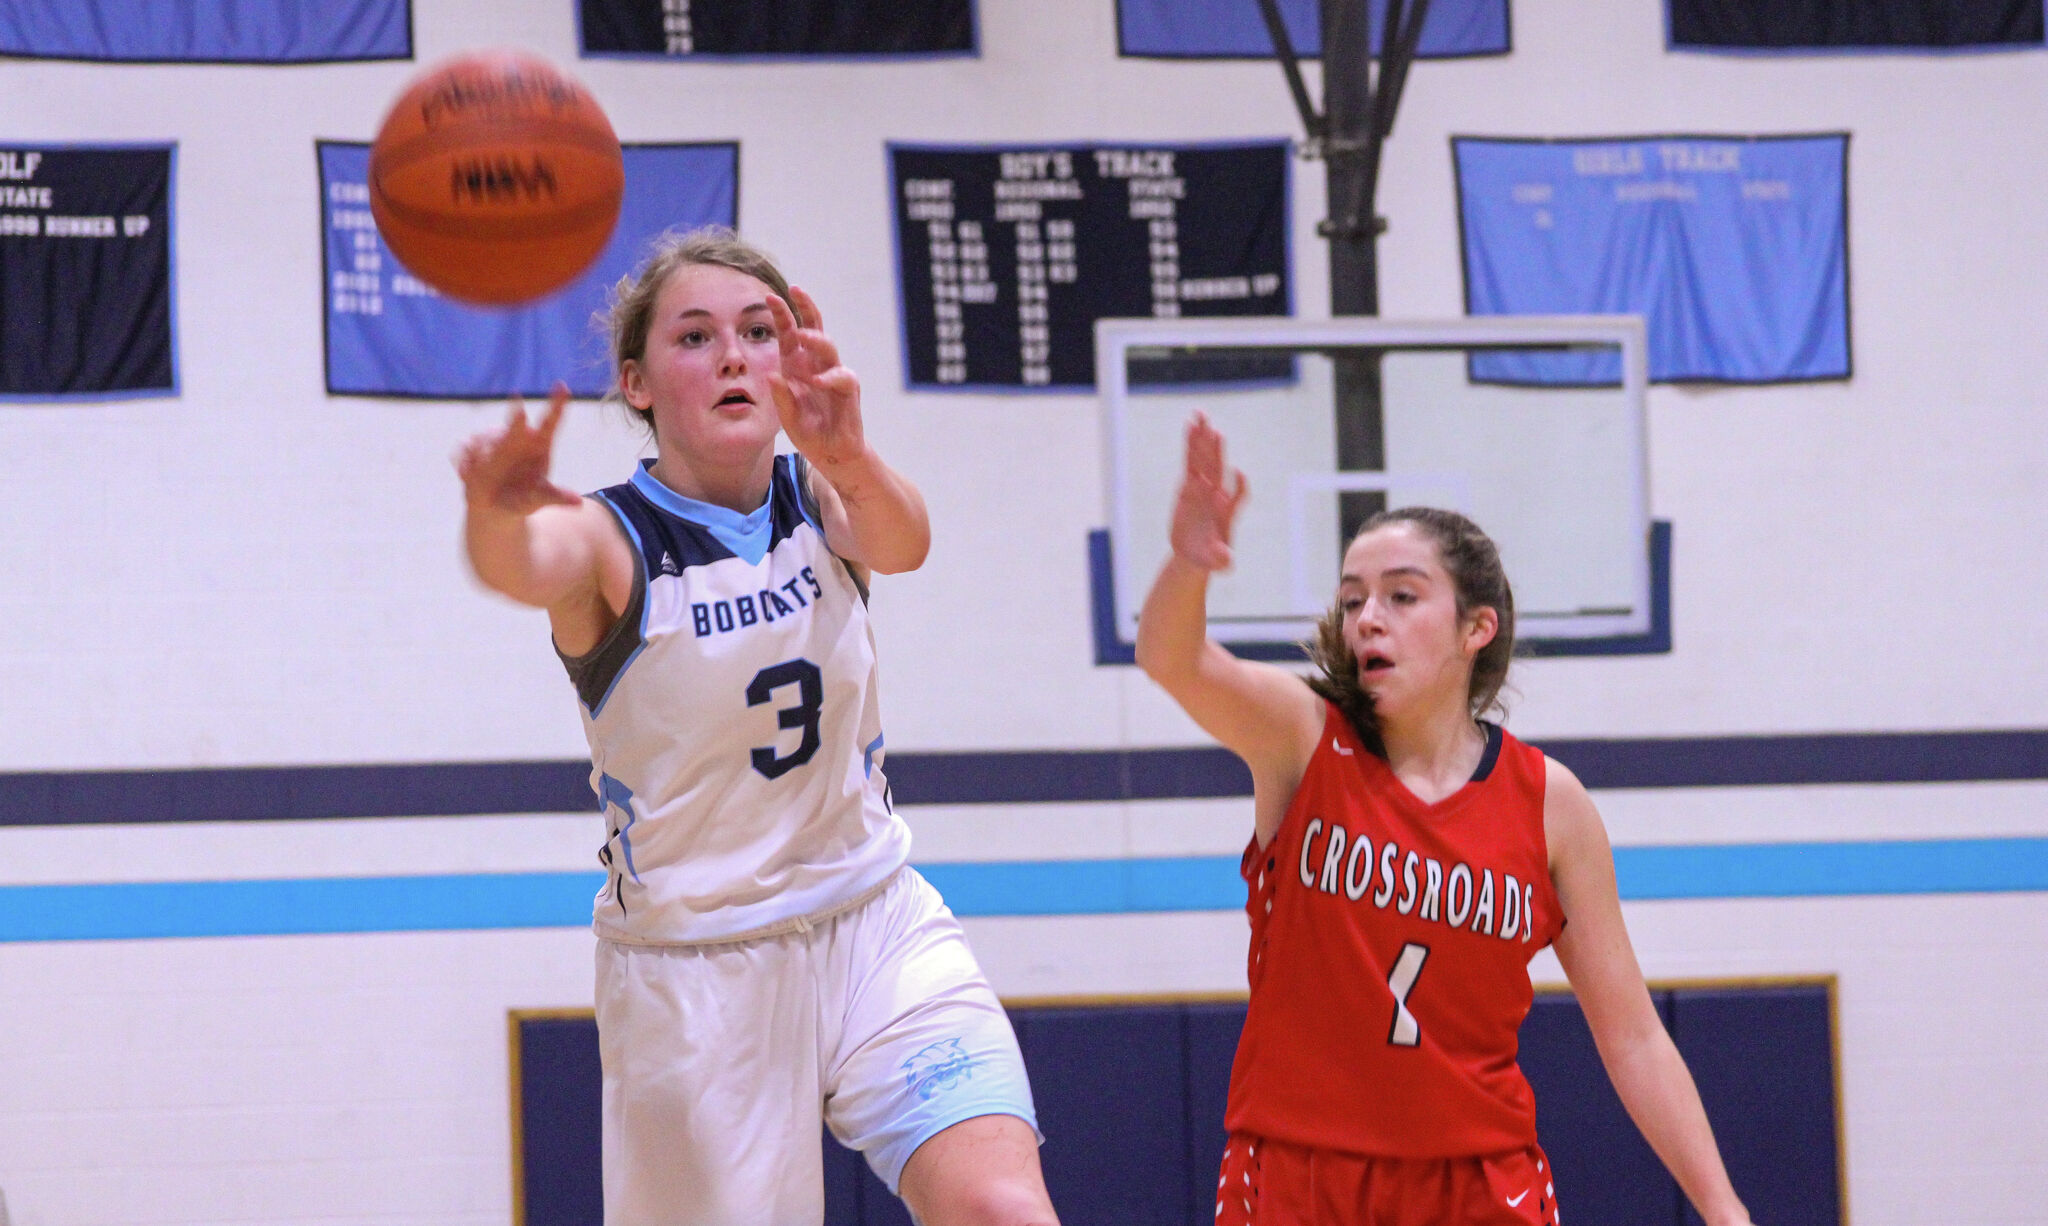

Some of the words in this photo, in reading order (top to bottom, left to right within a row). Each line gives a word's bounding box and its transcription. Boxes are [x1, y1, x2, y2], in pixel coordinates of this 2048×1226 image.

[1094, 150, 1175, 178] TRACK
[123, 215, 150, 238] UP
[1251, 273, 1280, 297] UP
[691, 566, 823, 638] BOBCATS
[745, 657, 824, 781] 3
[1299, 817, 1534, 944] CROSSROADS
[1387, 942, 1431, 1047] 1
